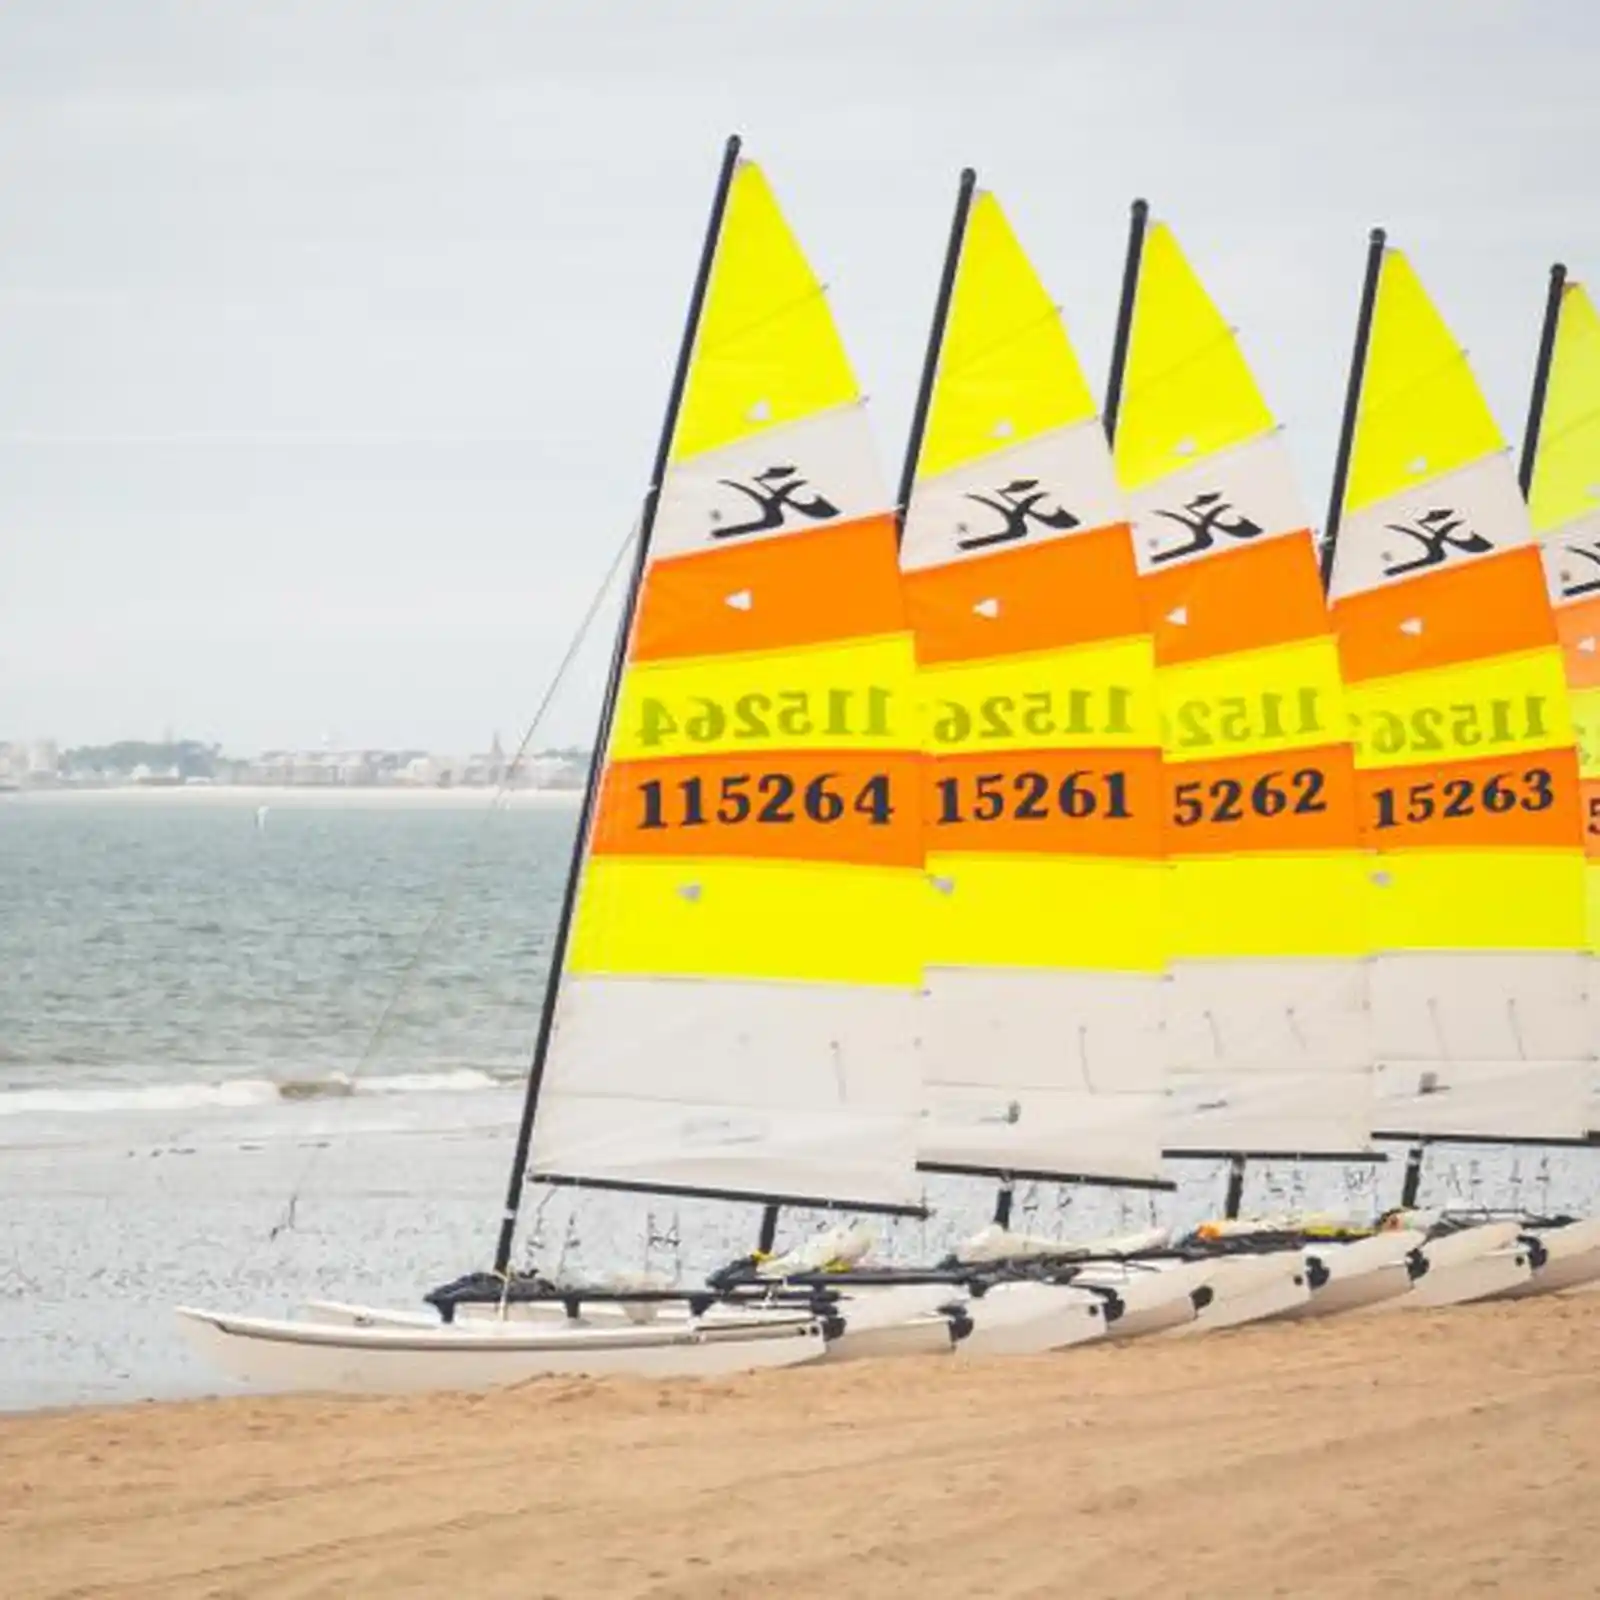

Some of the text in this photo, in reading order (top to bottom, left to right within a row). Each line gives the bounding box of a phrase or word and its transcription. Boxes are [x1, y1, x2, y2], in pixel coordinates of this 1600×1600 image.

[637, 772, 895, 829] 115264
[936, 769, 1134, 825] 15261
[1173, 768, 1327, 827] 5262
[1372, 768, 1555, 830] 15263
